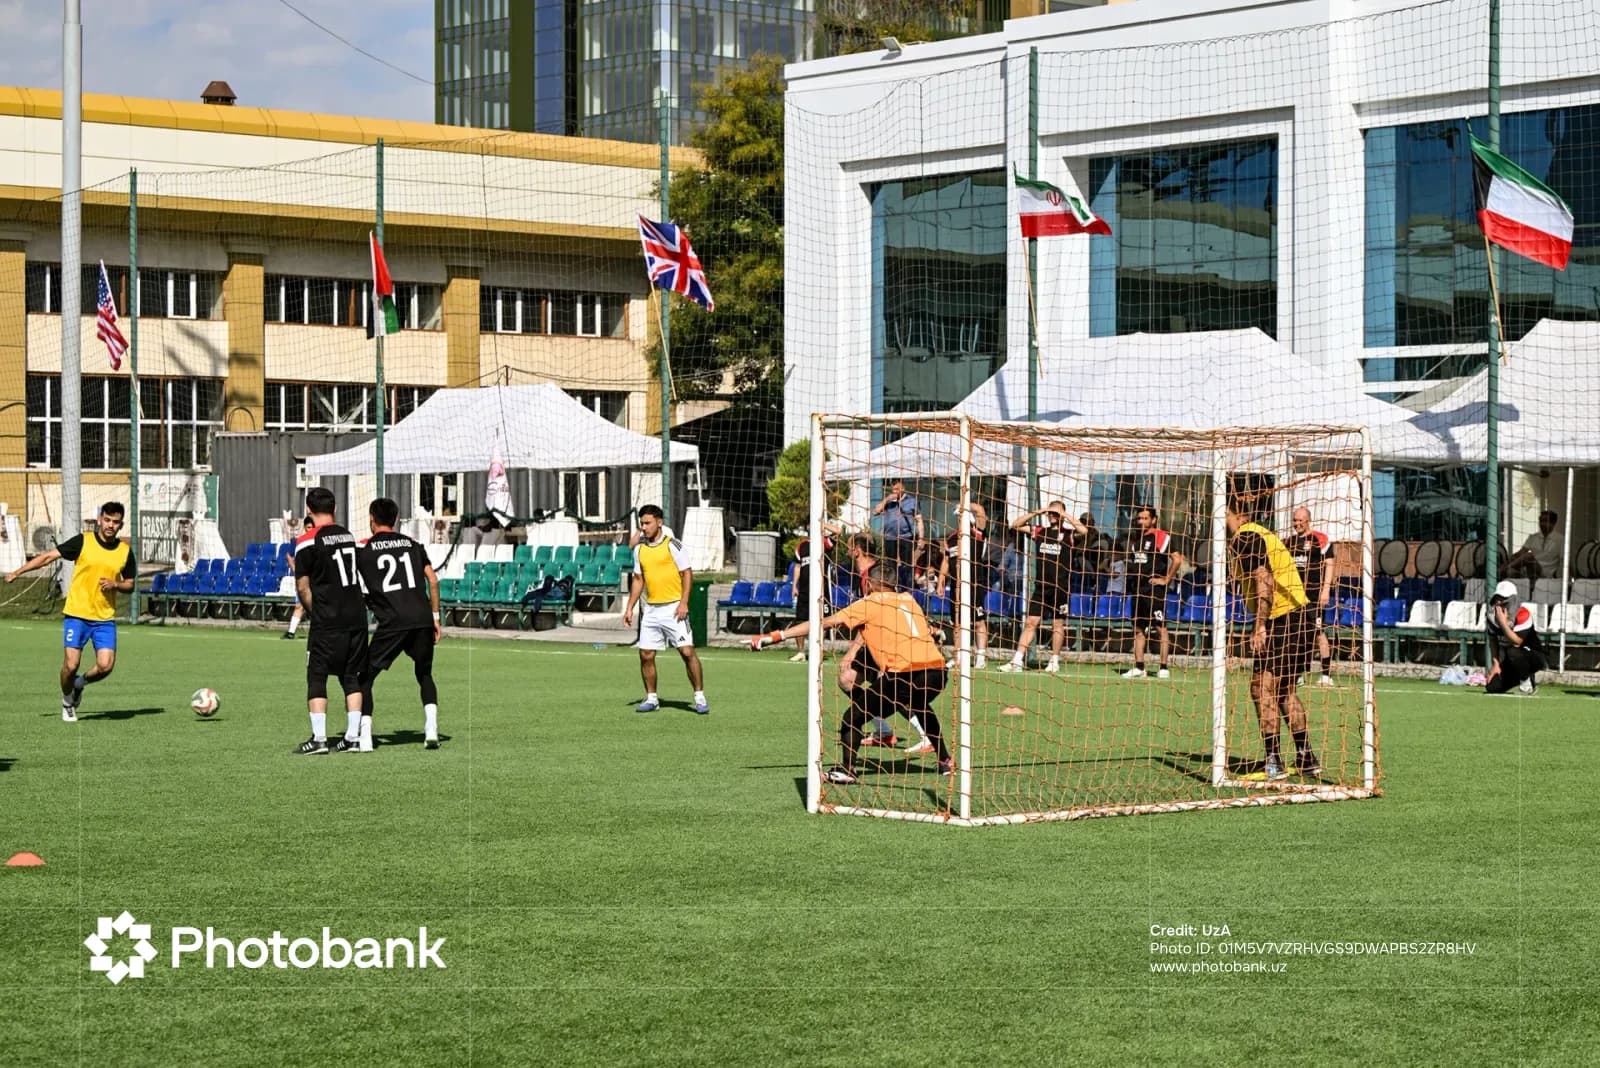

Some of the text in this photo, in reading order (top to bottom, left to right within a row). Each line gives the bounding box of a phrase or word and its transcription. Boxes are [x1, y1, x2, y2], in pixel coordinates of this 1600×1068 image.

[370, 538, 412, 551] КОСИМОВ
[332, 546, 357, 587] 17
[377, 551, 416, 593] 21
[66, 628, 74, 642] 2
[897, 603, 920, 638] 1
